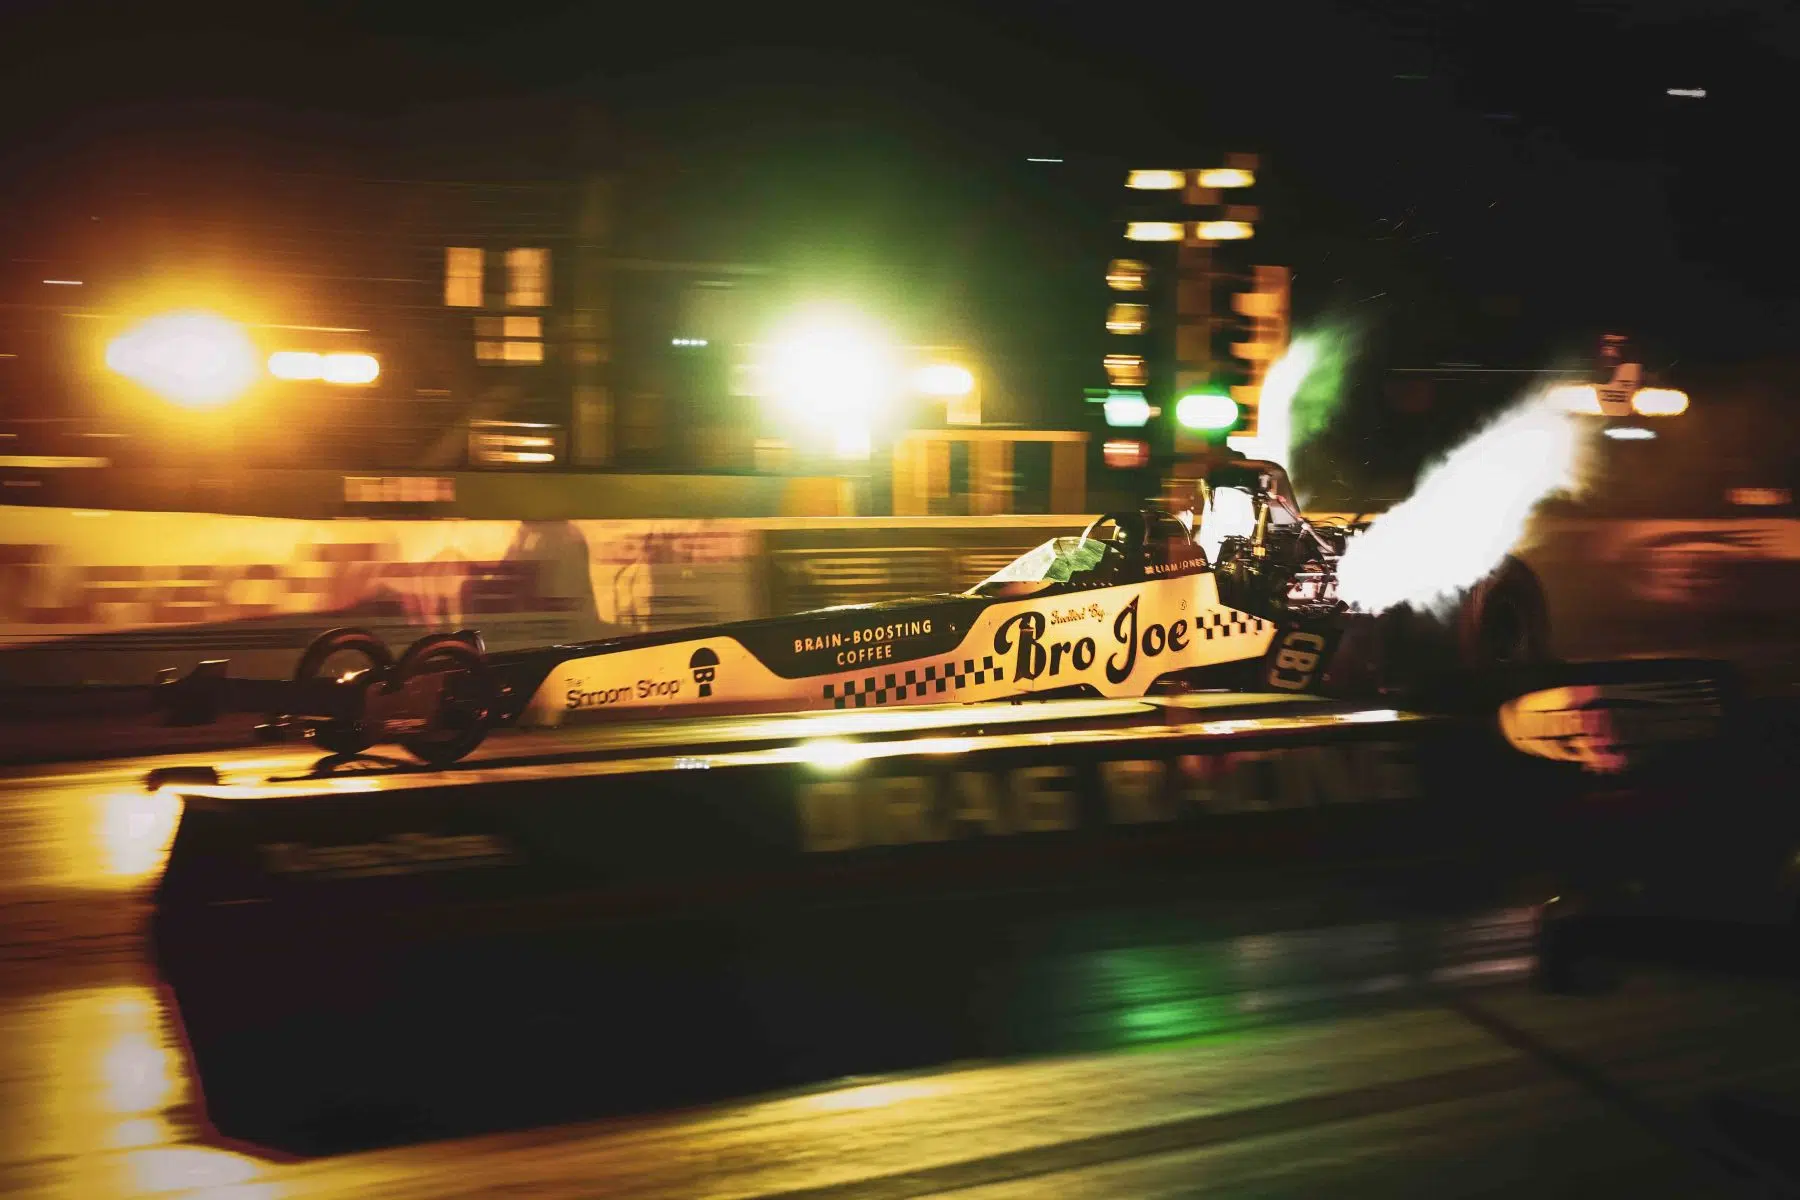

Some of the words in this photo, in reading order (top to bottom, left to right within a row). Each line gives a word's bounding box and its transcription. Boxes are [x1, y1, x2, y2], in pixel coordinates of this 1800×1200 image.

[1154, 563, 1179, 573] LIAM
[1179, 558, 1207, 570] JONES
[794, 619, 933, 653] BRAIN-BOOSTING
[993, 610, 1096, 684] Bro
[1105, 594, 1190, 684] Joe
[836, 645, 893, 666] COFFEE
[566, 686, 634, 709] Shroom
[636, 679, 681, 699] Shop
